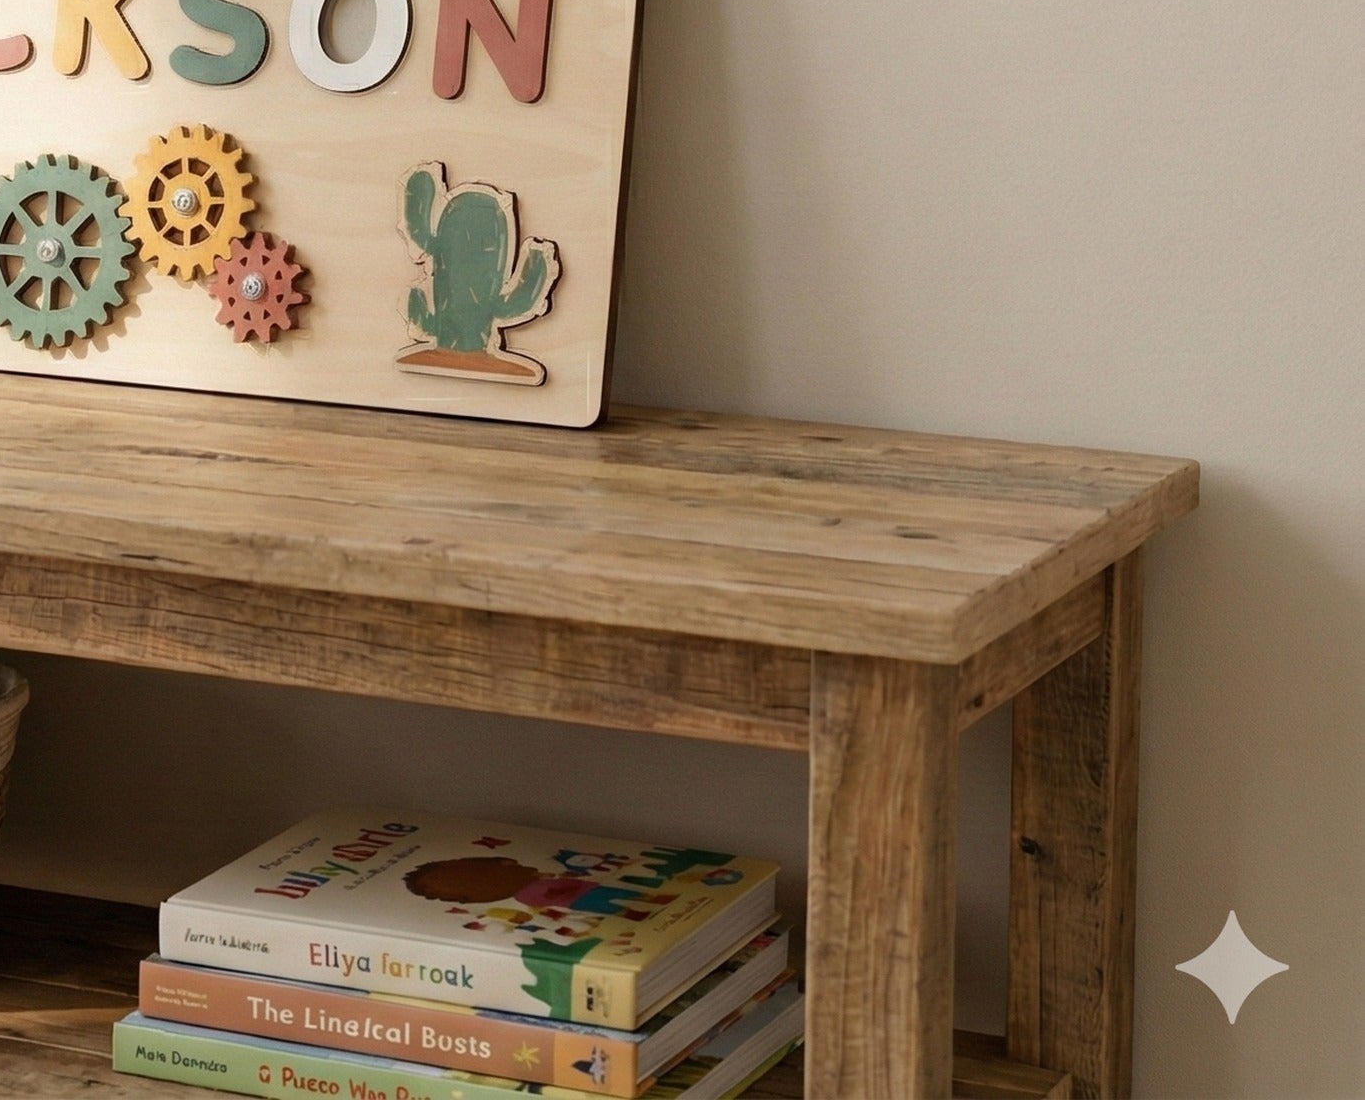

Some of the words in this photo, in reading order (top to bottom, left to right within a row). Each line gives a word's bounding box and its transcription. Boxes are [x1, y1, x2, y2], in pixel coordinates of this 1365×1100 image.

[309, 942, 371, 978] Eliya
[246, 995, 295, 1025] The
[421, 1025, 492, 1059] Busts
